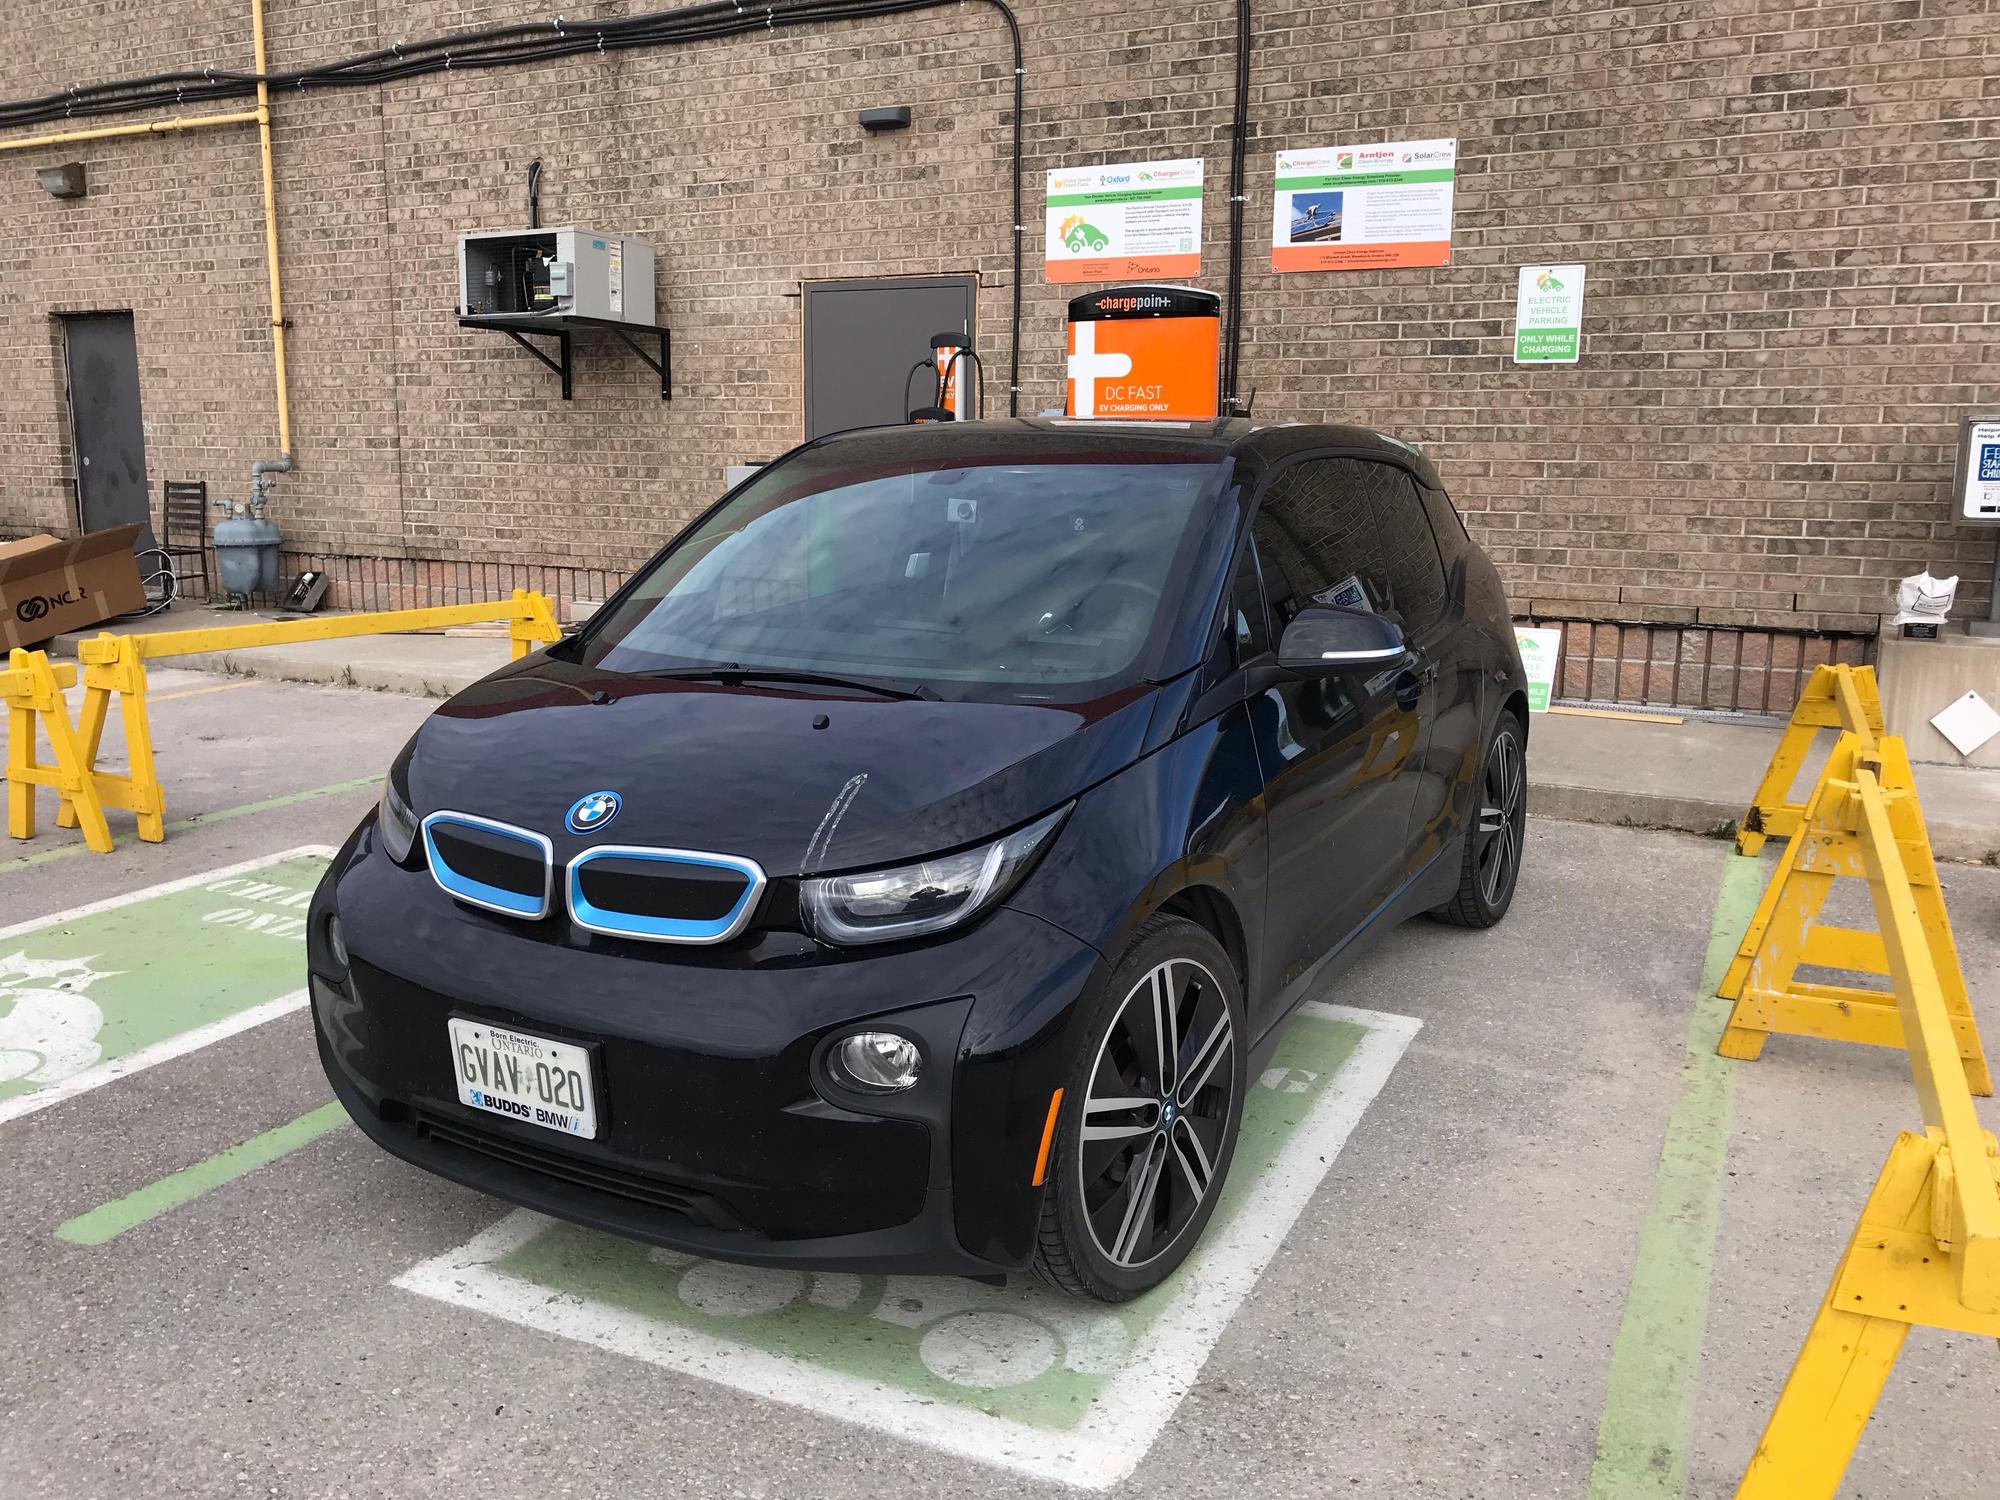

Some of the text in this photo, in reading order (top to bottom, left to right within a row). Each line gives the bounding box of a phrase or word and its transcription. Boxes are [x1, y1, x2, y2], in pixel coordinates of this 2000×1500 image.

[1358, 151, 1395, 160] Arntjen
[1414, 151, 1452, 160] SolarCrew
[1107, 175, 1131, 185] Oxford
[1528, 296, 1572, 305] ELECTRIC
[1531, 306, 1568, 314] VEHICLE
[1529, 316, 1568, 325] PARKING
[1520, 334, 1575, 343] ONLY WHILE
[1522, 345, 1572, 354] CHARGING
[1105, 385, 1163, 401] DC FAST
[1099, 403, 1169, 412] EV CHARGING ONLY
[1982, 459, 2000, 469] STA
[490, 1030, 508, 1040] Born
[491, 1037, 543, 1059] ONTARIO
[460, 1043, 585, 1112] GVAV 020
[536, 1108, 568, 1129] BMW
